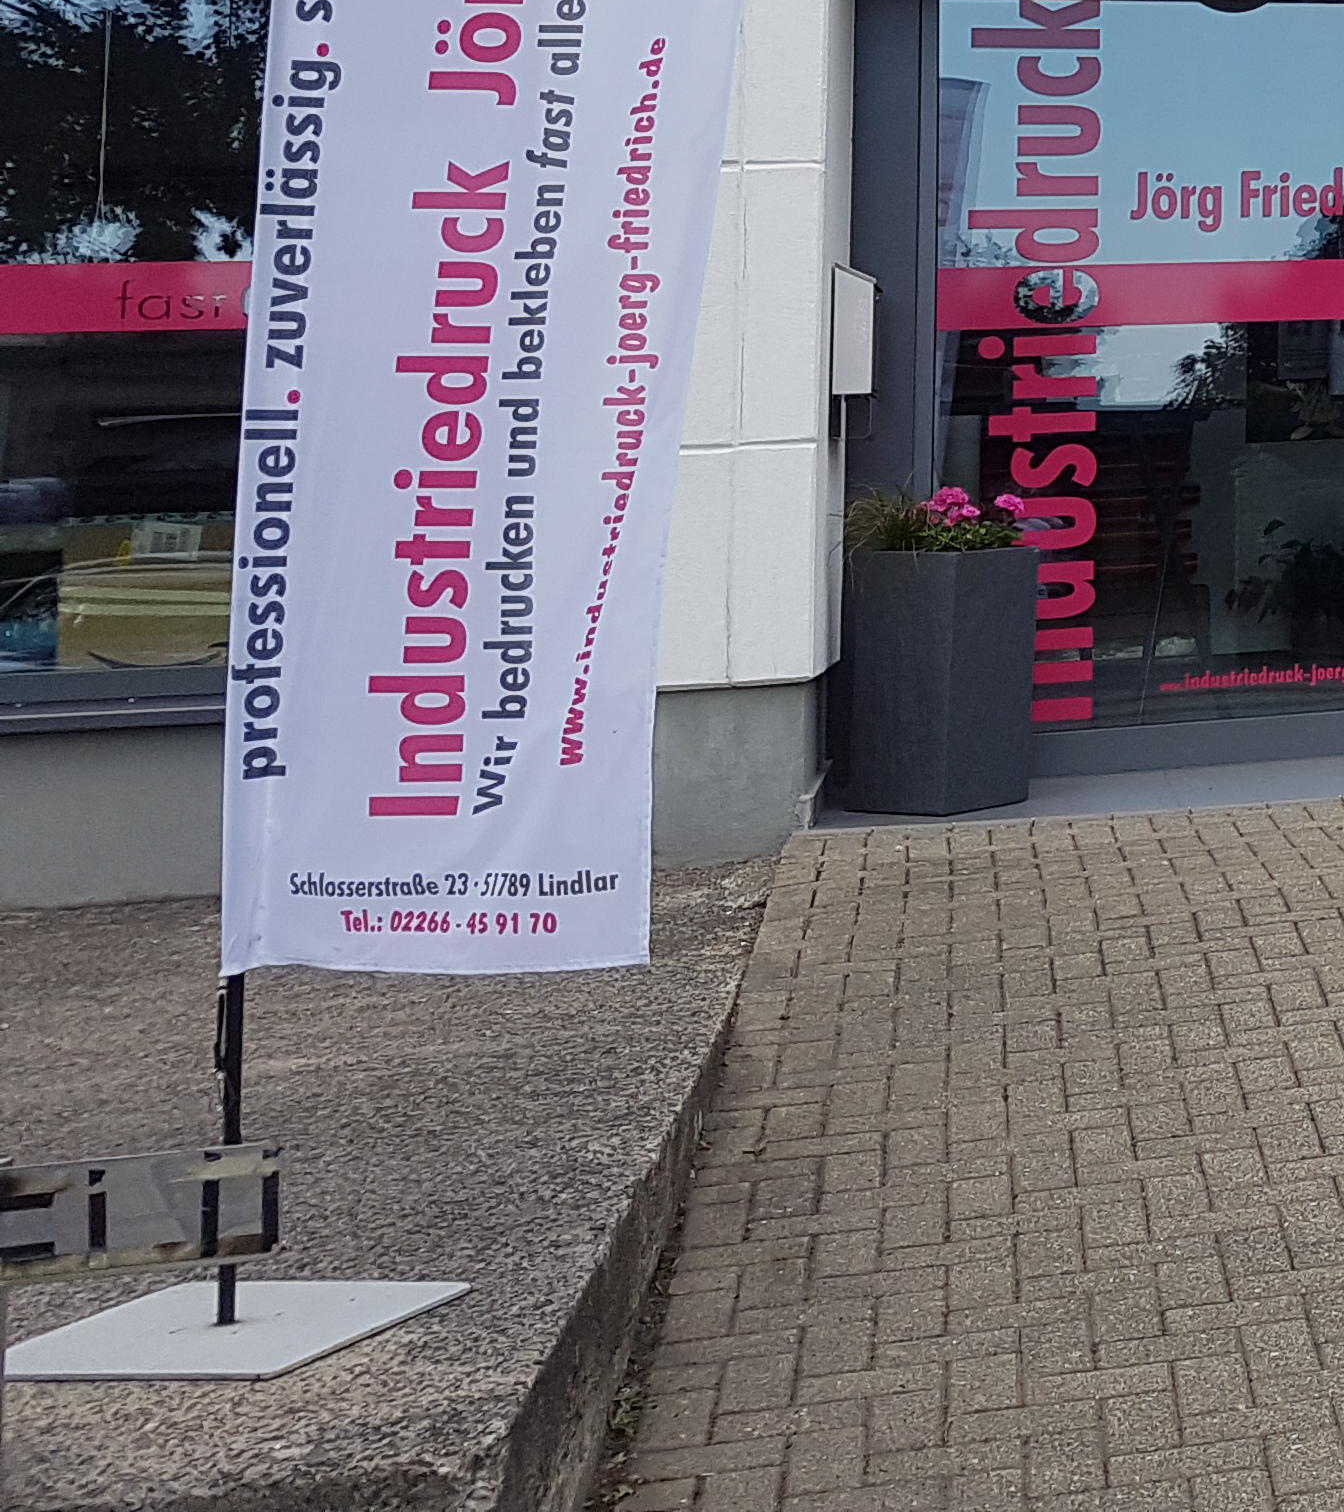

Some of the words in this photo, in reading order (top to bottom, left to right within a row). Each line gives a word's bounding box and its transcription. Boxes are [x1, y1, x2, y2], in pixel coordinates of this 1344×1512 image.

[525, 89, 576, 171] fast
[260, 41, 342, 370] zuverlässig.
[1130, 169, 1224, 232] Jörg
[500, 183, 566, 380] bekleben
[498, 397, 541, 478] und
[559, 37, 666, 766] www.industriedruck-joerg-friedrich.de
[366, 159, 512, 818] Industriedruck
[231, 390, 303, 782] professionell.
[481, 493, 535, 720] bedrucken
[471, 733, 518, 816] Wir
[289, 871, 440, 898] Schlosserstraße
[444, 872, 469, 897] 23
[538, 869, 619, 897] Lindlar
[340, 909, 383, 933] Tel.:
[390, 910, 450, 934] 02266
[466, 912, 488, 935] 45
[495, 912, 519, 935] 91
[529, 912, 558, 934] 70
